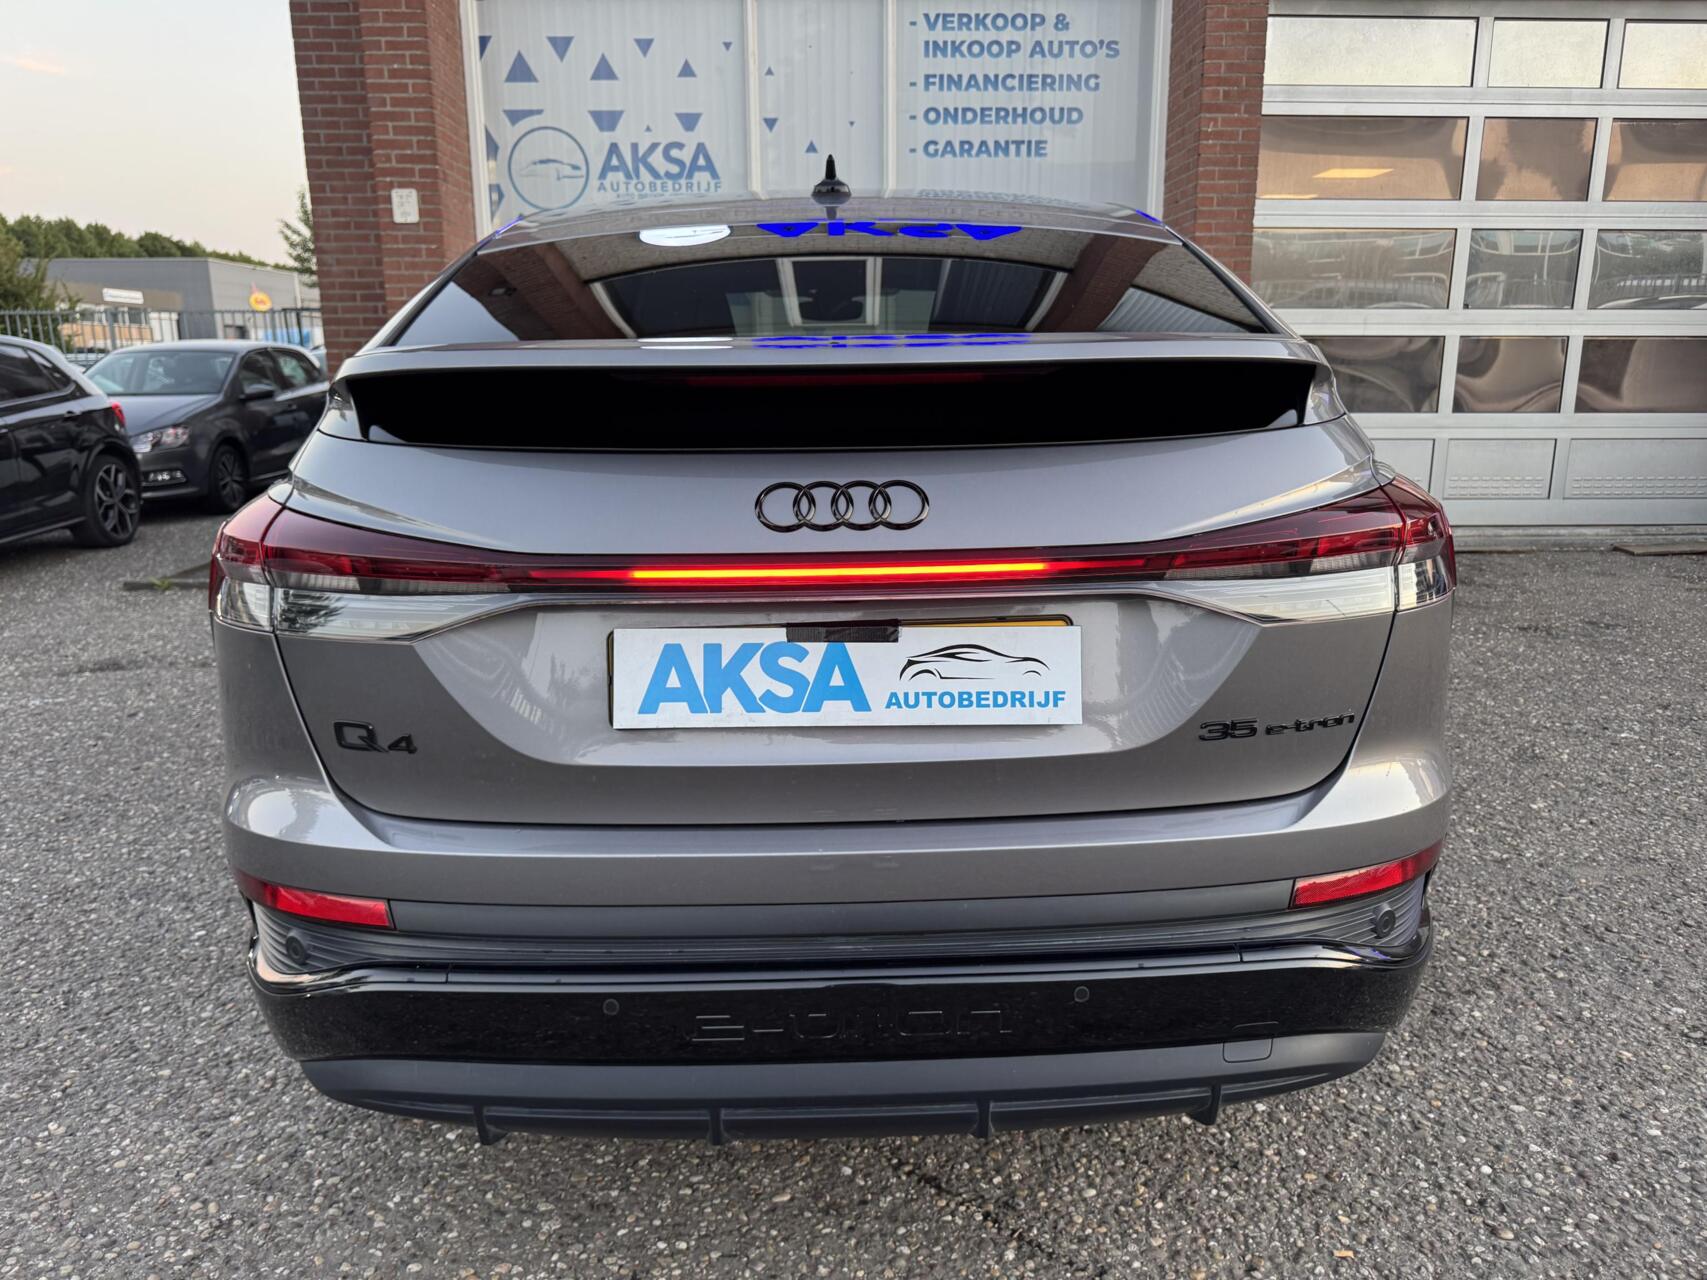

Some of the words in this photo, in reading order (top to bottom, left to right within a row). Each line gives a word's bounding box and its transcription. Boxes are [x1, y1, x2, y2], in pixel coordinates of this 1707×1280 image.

[922, 12, 1046, 32] VERKOOP
[1053, 12, 1070, 32] &
[923, 39, 1022, 59] INKOOP
[923, 73, 1101, 92] FINANCIERING
[922, 106, 1084, 126] ONDERHOUD
[922, 139, 1048, 159] GARANTIE
[597, 141, 721, 181] AKSA
[597, 181, 722, 193] AUTOBEDRIJF
[637, 641, 872, 715] AKSA
[885, 690, 1067, 709] AUTOBEDRIJF
[1198, 717, 1258, 742] 35
[1265, 712, 1355, 736] e-tron
[333, 721, 418, 754] Q4
